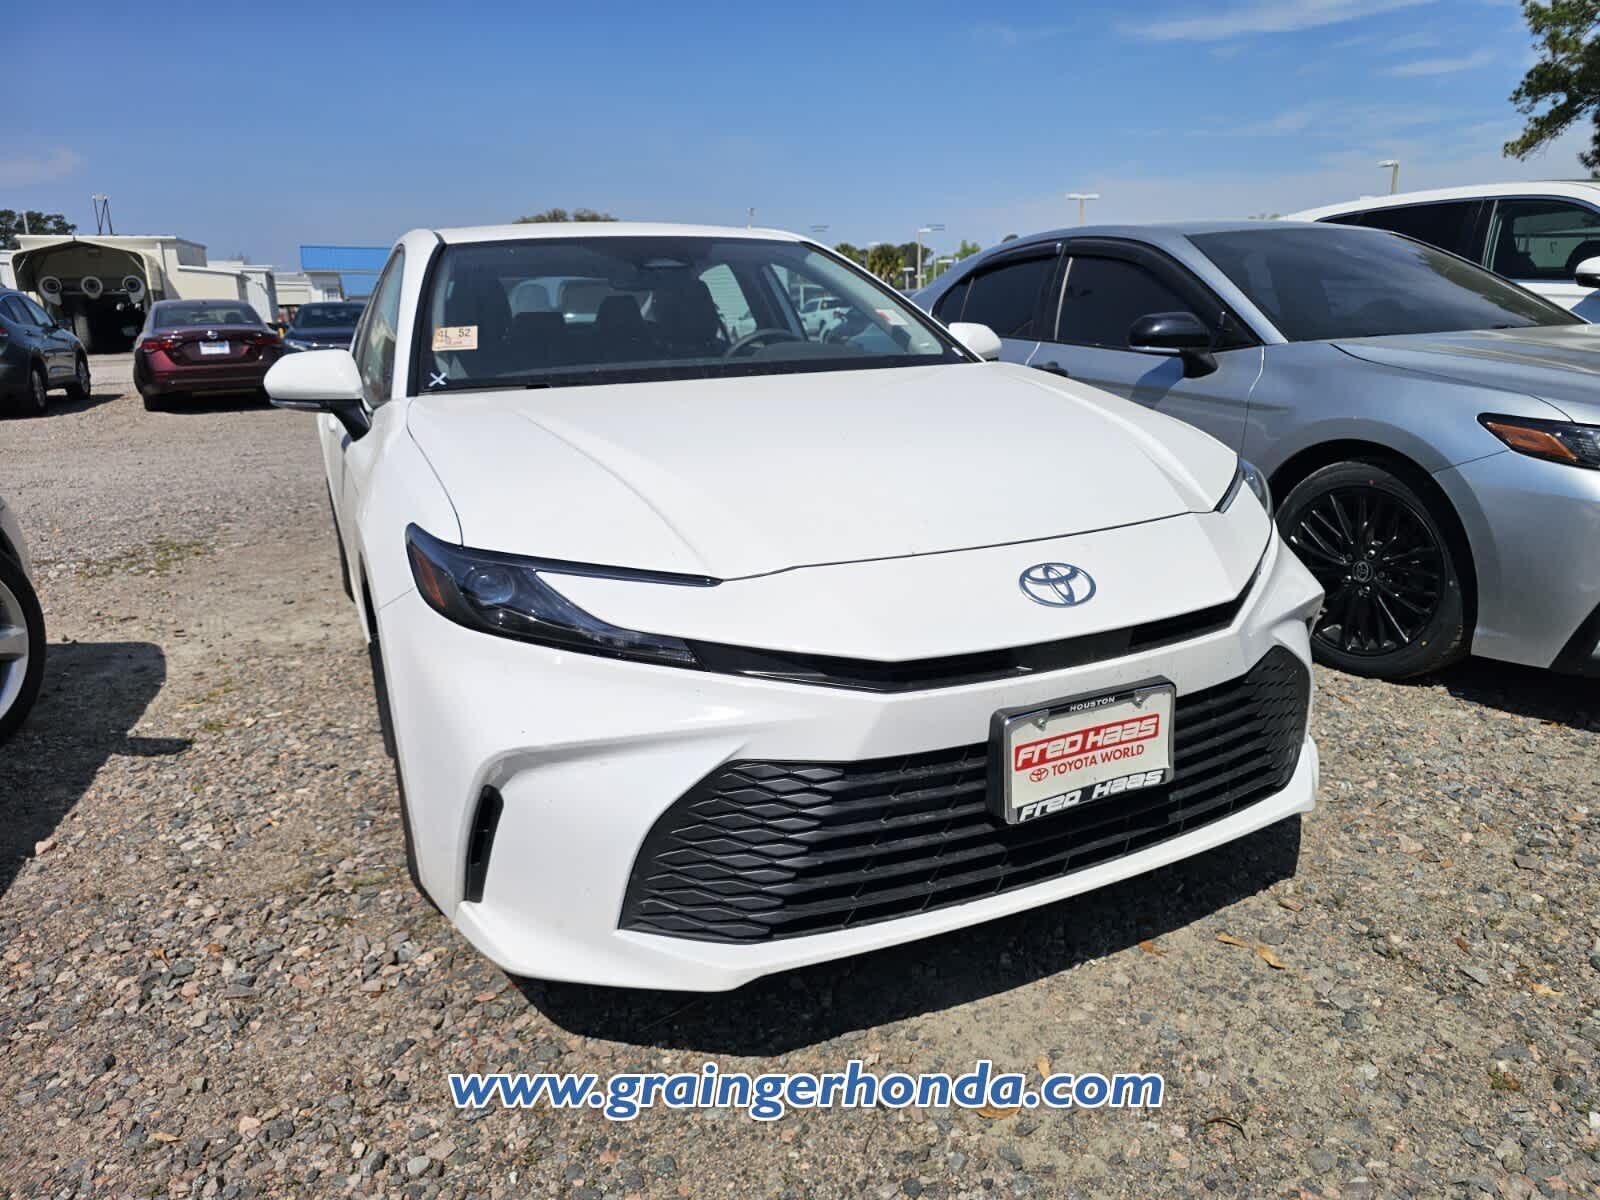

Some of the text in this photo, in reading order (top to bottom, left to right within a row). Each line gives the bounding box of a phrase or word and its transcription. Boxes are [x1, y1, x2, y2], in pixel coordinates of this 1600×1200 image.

[1069, 696, 1116, 712] HOUSTON
[1051, 744, 1145, 777] TOYOTA WORLD
